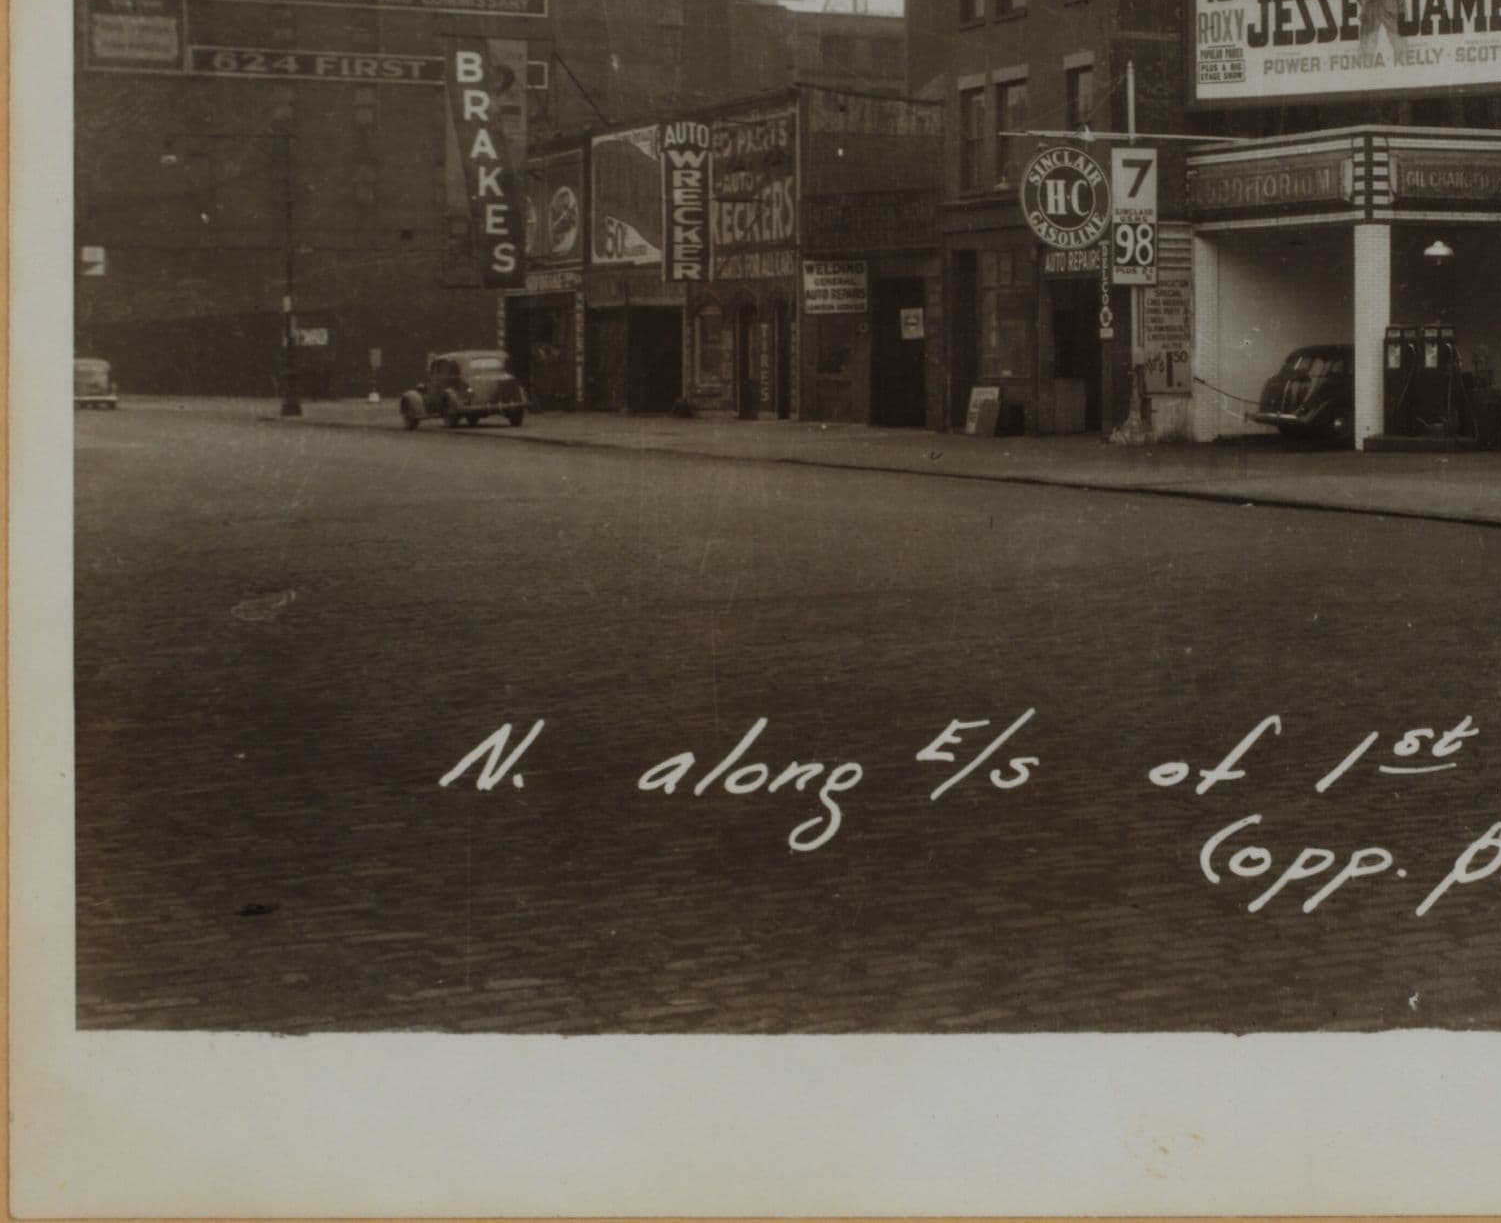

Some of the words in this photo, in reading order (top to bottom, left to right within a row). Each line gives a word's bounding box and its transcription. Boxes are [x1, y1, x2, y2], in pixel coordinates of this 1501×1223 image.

[1198, 9, 1245, 44] ROXY
[213, 52, 299, 73] 624
[316, 57, 428, 78] FIRST
[1263, 55, 1321, 75] POWER
[1330, 52, 1386, 71] FONDA
[1393, 47, 1445, 68] KELLY
[665, 121, 710, 148] AUTO
[456, 51, 516, 273] BRAKES
[1028, 148, 1103, 186] SINCLAIR
[1120, 159, 1153, 198] 7
[667, 149, 707, 281] WRECKER
[712, 176, 794, 245] RECKERS
[1029, 210, 1106, 247] GASOLINE
[1045, 251, 1066, 273] AUTO
[1068, 249, 1100, 272] REPAIRS
[1116, 224, 1153, 265] 98
[805, 263, 865, 275] WELDING
